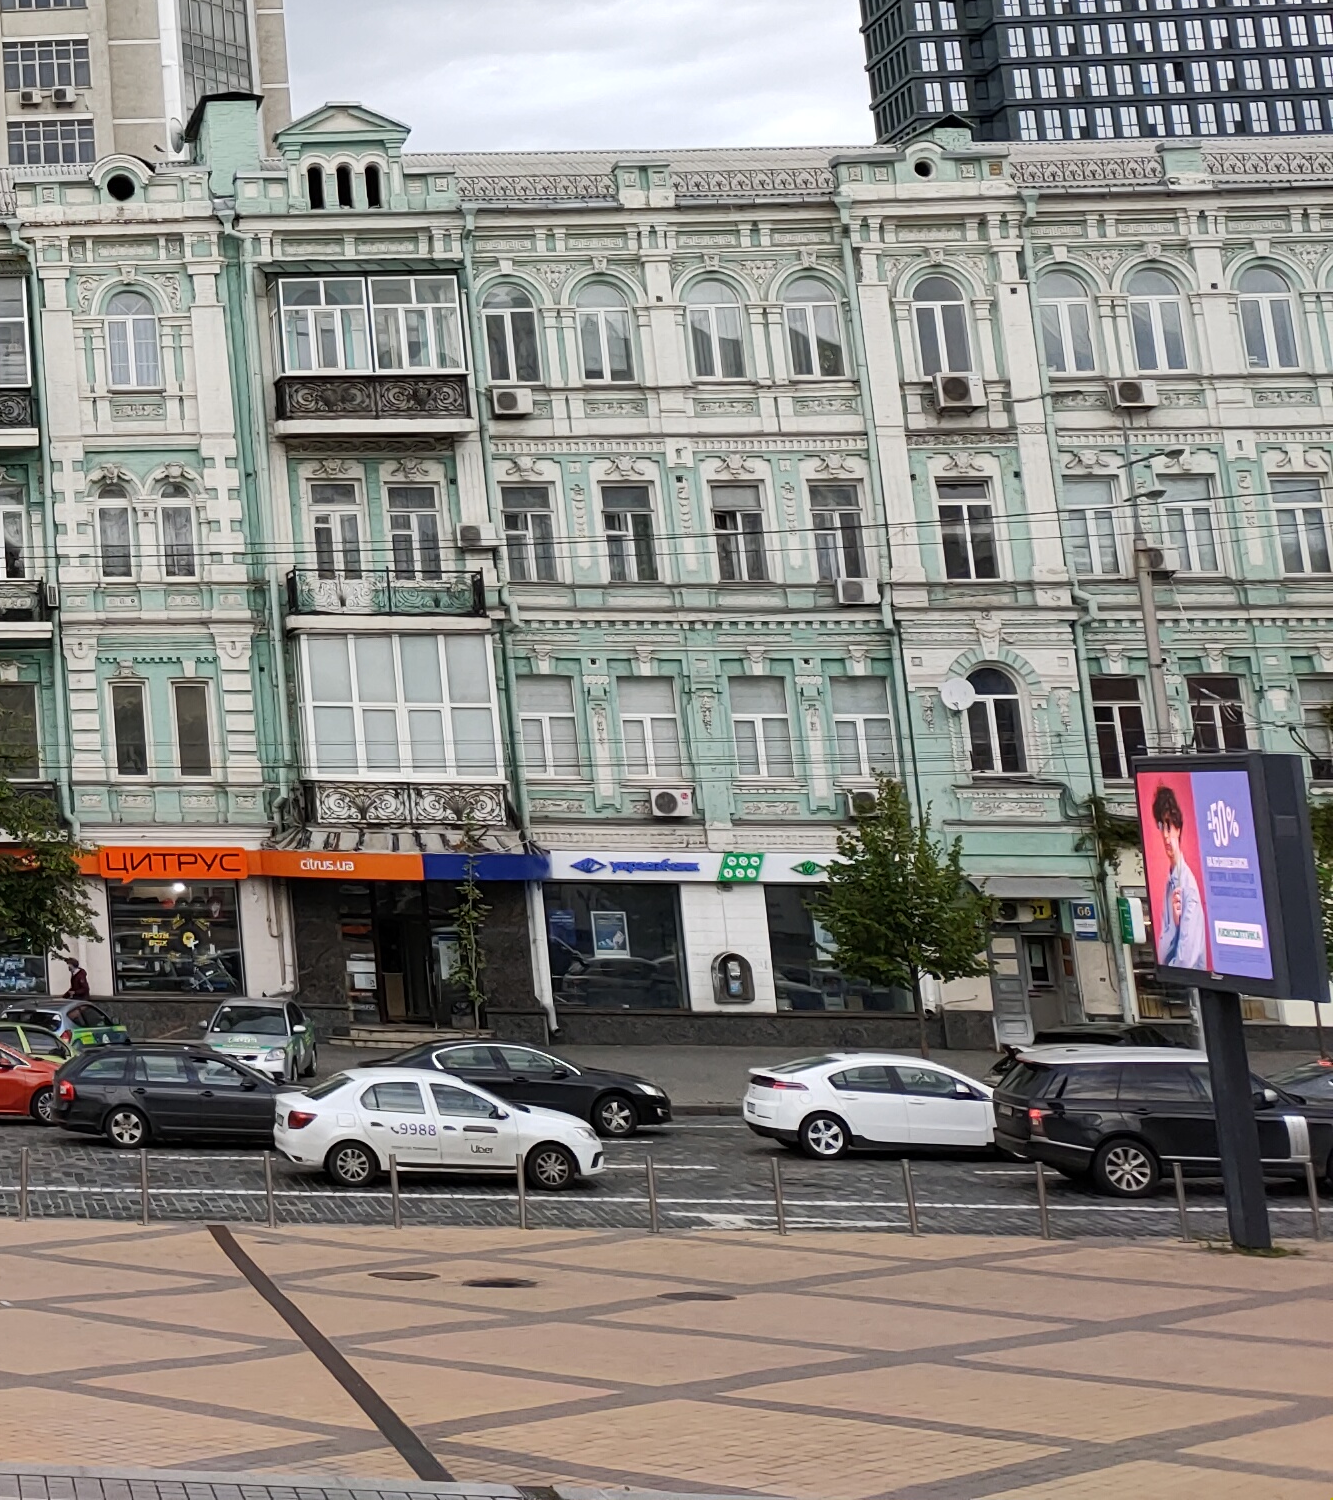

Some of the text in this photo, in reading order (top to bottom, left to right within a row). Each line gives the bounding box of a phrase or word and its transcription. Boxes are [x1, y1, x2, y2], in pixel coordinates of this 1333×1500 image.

[105, 852, 241, 875] ЦИТРУС
[300, 858, 355, 872] citrus.ua
[399, 1123, 437, 1136] 9988
[471, 1144, 493, 1154] Uber
